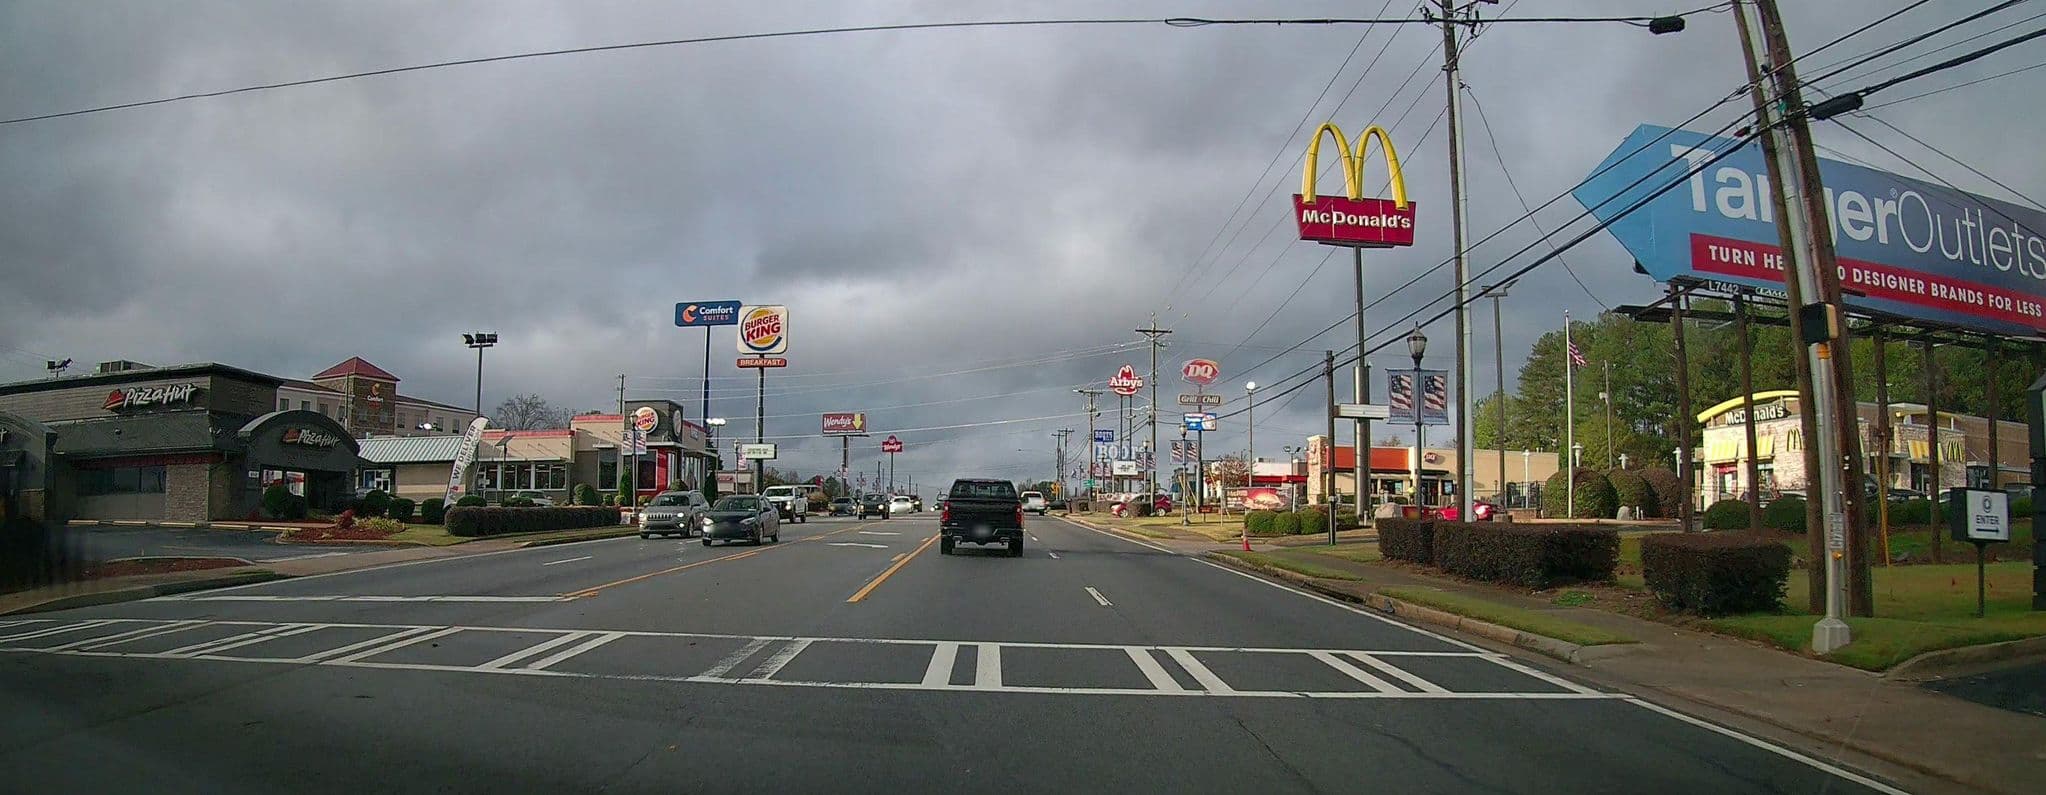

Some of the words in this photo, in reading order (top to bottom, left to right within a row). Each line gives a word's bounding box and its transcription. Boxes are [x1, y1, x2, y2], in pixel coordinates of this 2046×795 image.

[1302, 210, 1411, 228] McDonald's
[1708, 280, 1740, 295] L7442
[1709, 245, 1755, 266] TURN
[1764, 253, 1785, 270] HE
[1852, 268, 1925, 294] DESIGNER
[1931, 283, 1984, 305] BRANDS
[1988, 294, 2012, 311] FOR
[2016, 300, 2042, 317] LESS
[699, 305, 733, 315] Comfort
[745, 314, 779, 331] BURGER
[746, 322, 781, 341] KING
[740, 358, 780, 366] BREAKFAST
[1187, 364, 1213, 378] DQ
[1110, 376, 1143, 389] Arby's
[823, 415, 852, 428] Wendy's
[1725, 404, 1784, 424] McDnald's
[452, 463, 462, 480] WE
[460, 425, 477, 462] DELIVER
[1976, 515, 1999, 525] ENTER
